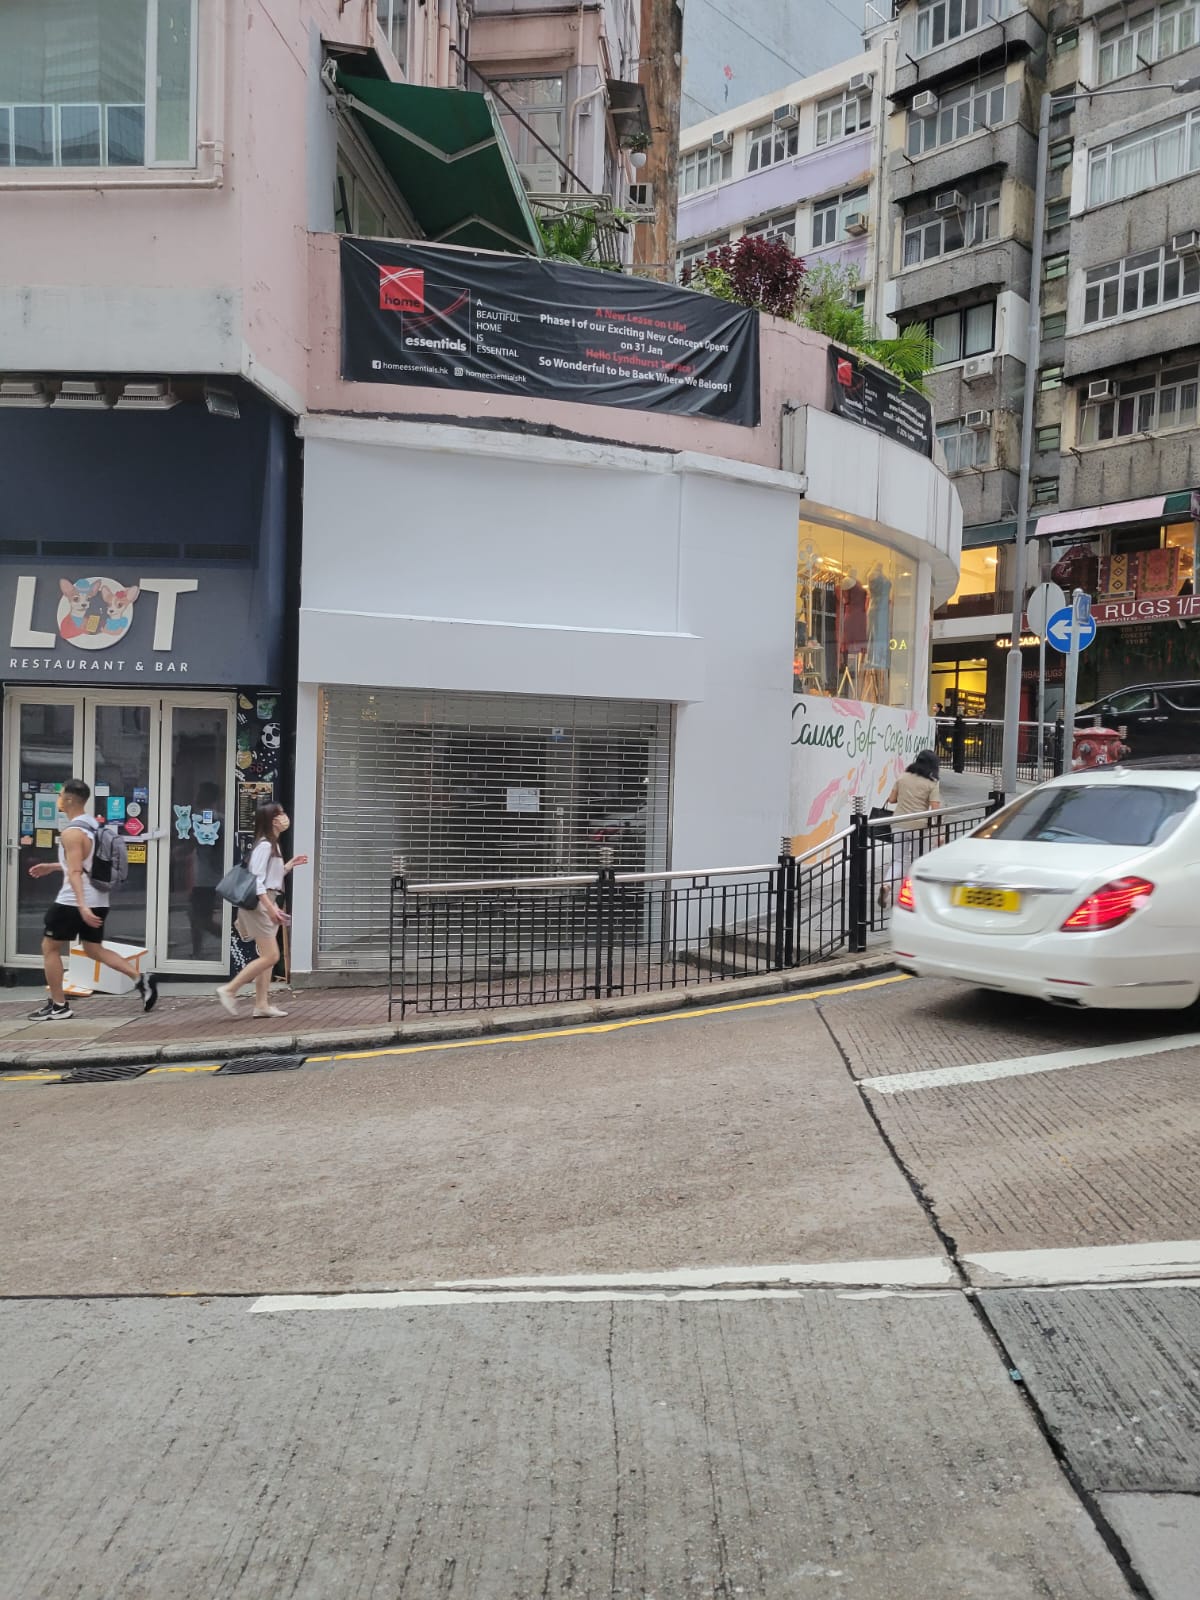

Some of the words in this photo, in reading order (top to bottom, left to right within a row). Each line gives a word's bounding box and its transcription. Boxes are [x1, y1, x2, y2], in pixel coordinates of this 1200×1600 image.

[384, 294, 422, 309] home
[476, 310, 521, 323] BEAUTIFUL
[596, 308, 603, 317] A
[605, 309, 624, 321] New
[627, 313, 652, 326] Lease
[654, 320, 666, 329] on
[668, 320, 687, 332] Life!
[476, 323, 503, 333] HOME
[540, 314, 570, 327] Phase
[577, 319, 588, 330] of
[589, 322, 606, 332] our
[607, 324, 645, 341] Exciting
[646, 331, 666, 343] New
[667, 334, 703, 351] Concept
[704, 340, 729, 353] Opens
[405, 336, 467, 352] essentials
[476, 334, 484, 342] IS
[476, 345, 520, 358] ESSENTIAL
[620, 342, 633, 351] on
[634, 342, 645, 352] 31
[647, 345, 663, 356] Jan
[585, 349, 611, 361] Hello
[613, 352, 659, 370] Lyndhurst
[382, 362, 449, 375] homeessentials.hk
[539, 356, 552, 367] So
[553, 358, 606, 375] Wonderful
[606, 366, 617, 376] to
[618, 367, 631, 378] be
[632, 370, 655, 382] Back
[655, 372, 684, 385] Where
[684, 376, 698, 387] We
[698, 379, 732, 393] Belong!
[465, 369, 527, 383] homeessentialshk
[1105, 599, 1171, 619] RUGS
[10, 658, 126, 671] RESTAURANT
[135, 661, 145, 671] &
[155, 661, 189, 672] BAR
